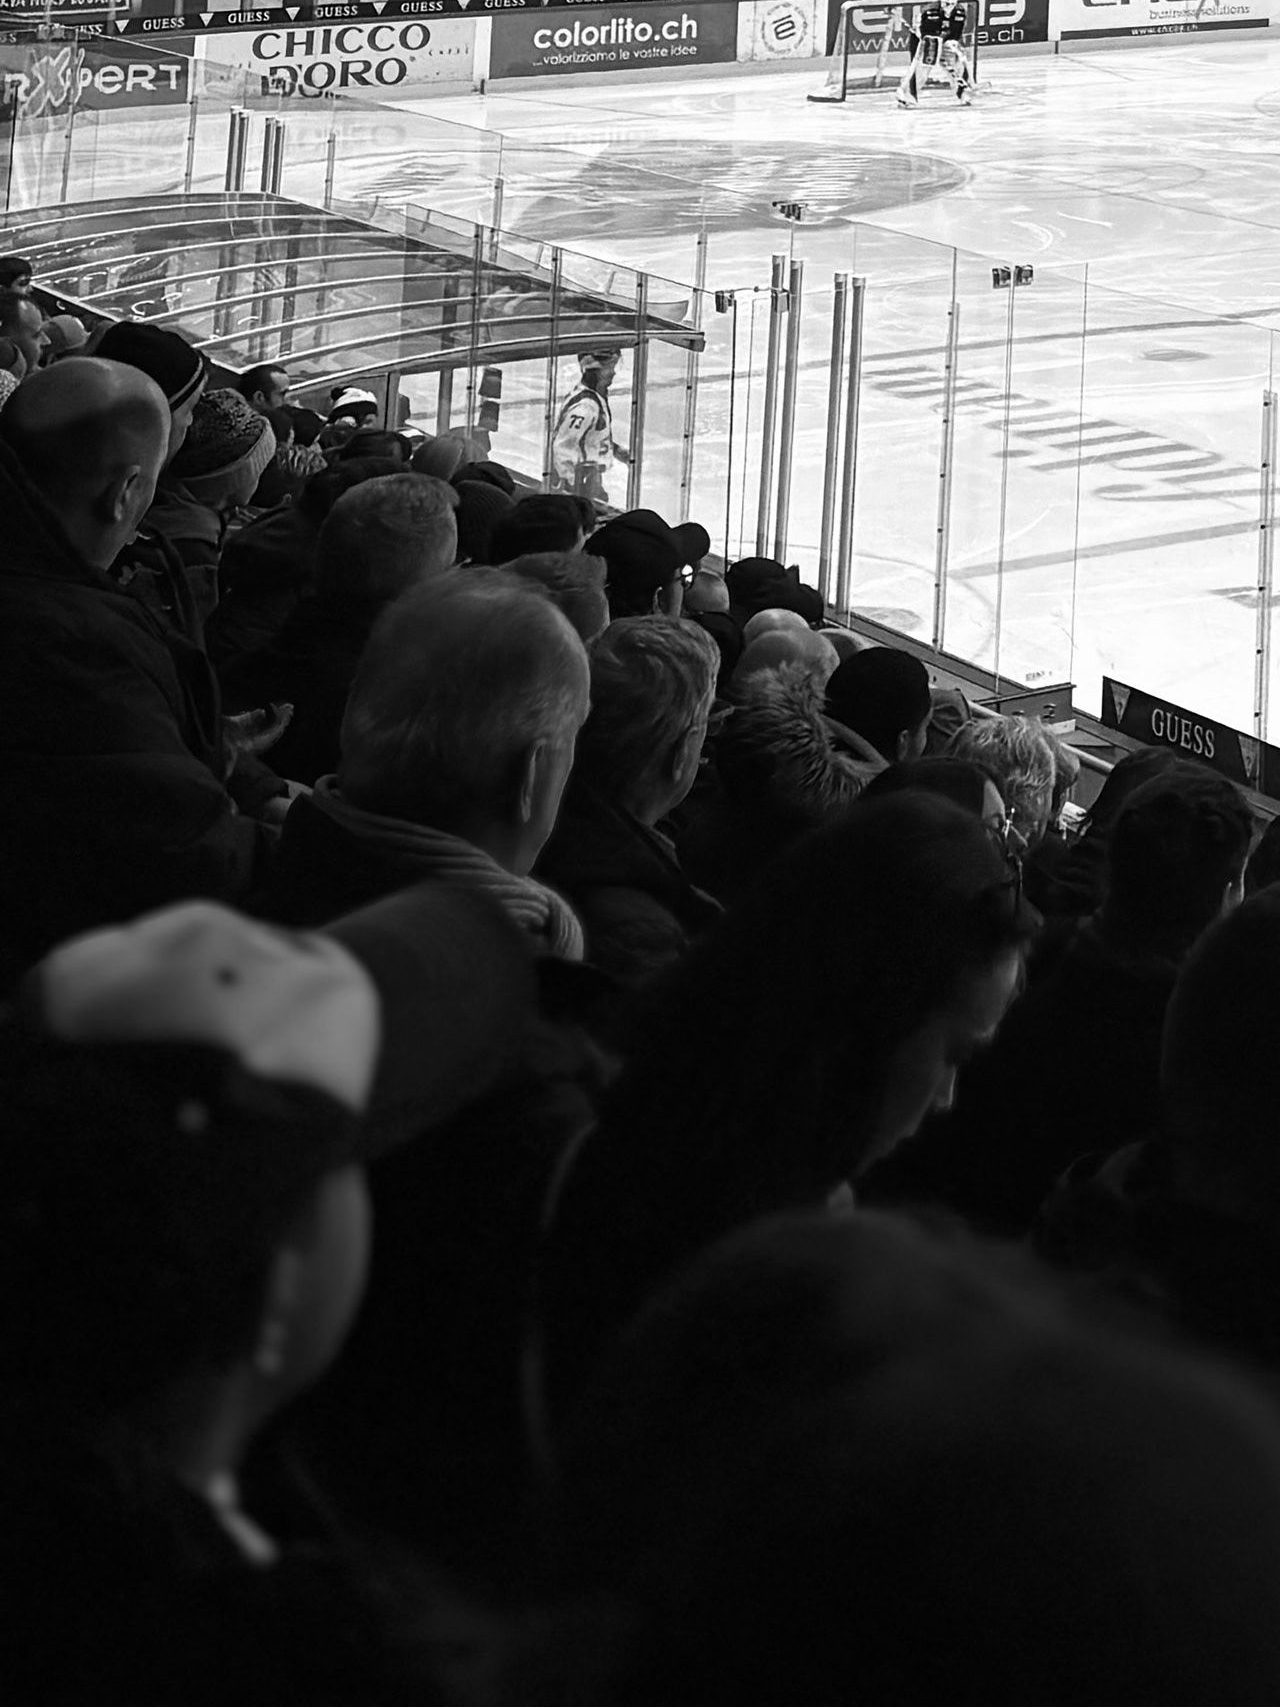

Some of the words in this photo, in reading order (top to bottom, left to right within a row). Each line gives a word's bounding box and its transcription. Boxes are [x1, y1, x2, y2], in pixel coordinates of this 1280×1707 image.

[143, 17, 185, 30] GUESS
[228, 11, 270, 24] GUESS
[252, 22, 431, 60] CHICCO
[533, 13, 698, 49] colorlito.ch
[671, 44, 697, 57] idee
[1151, 708, 1215, 759] GUESS
